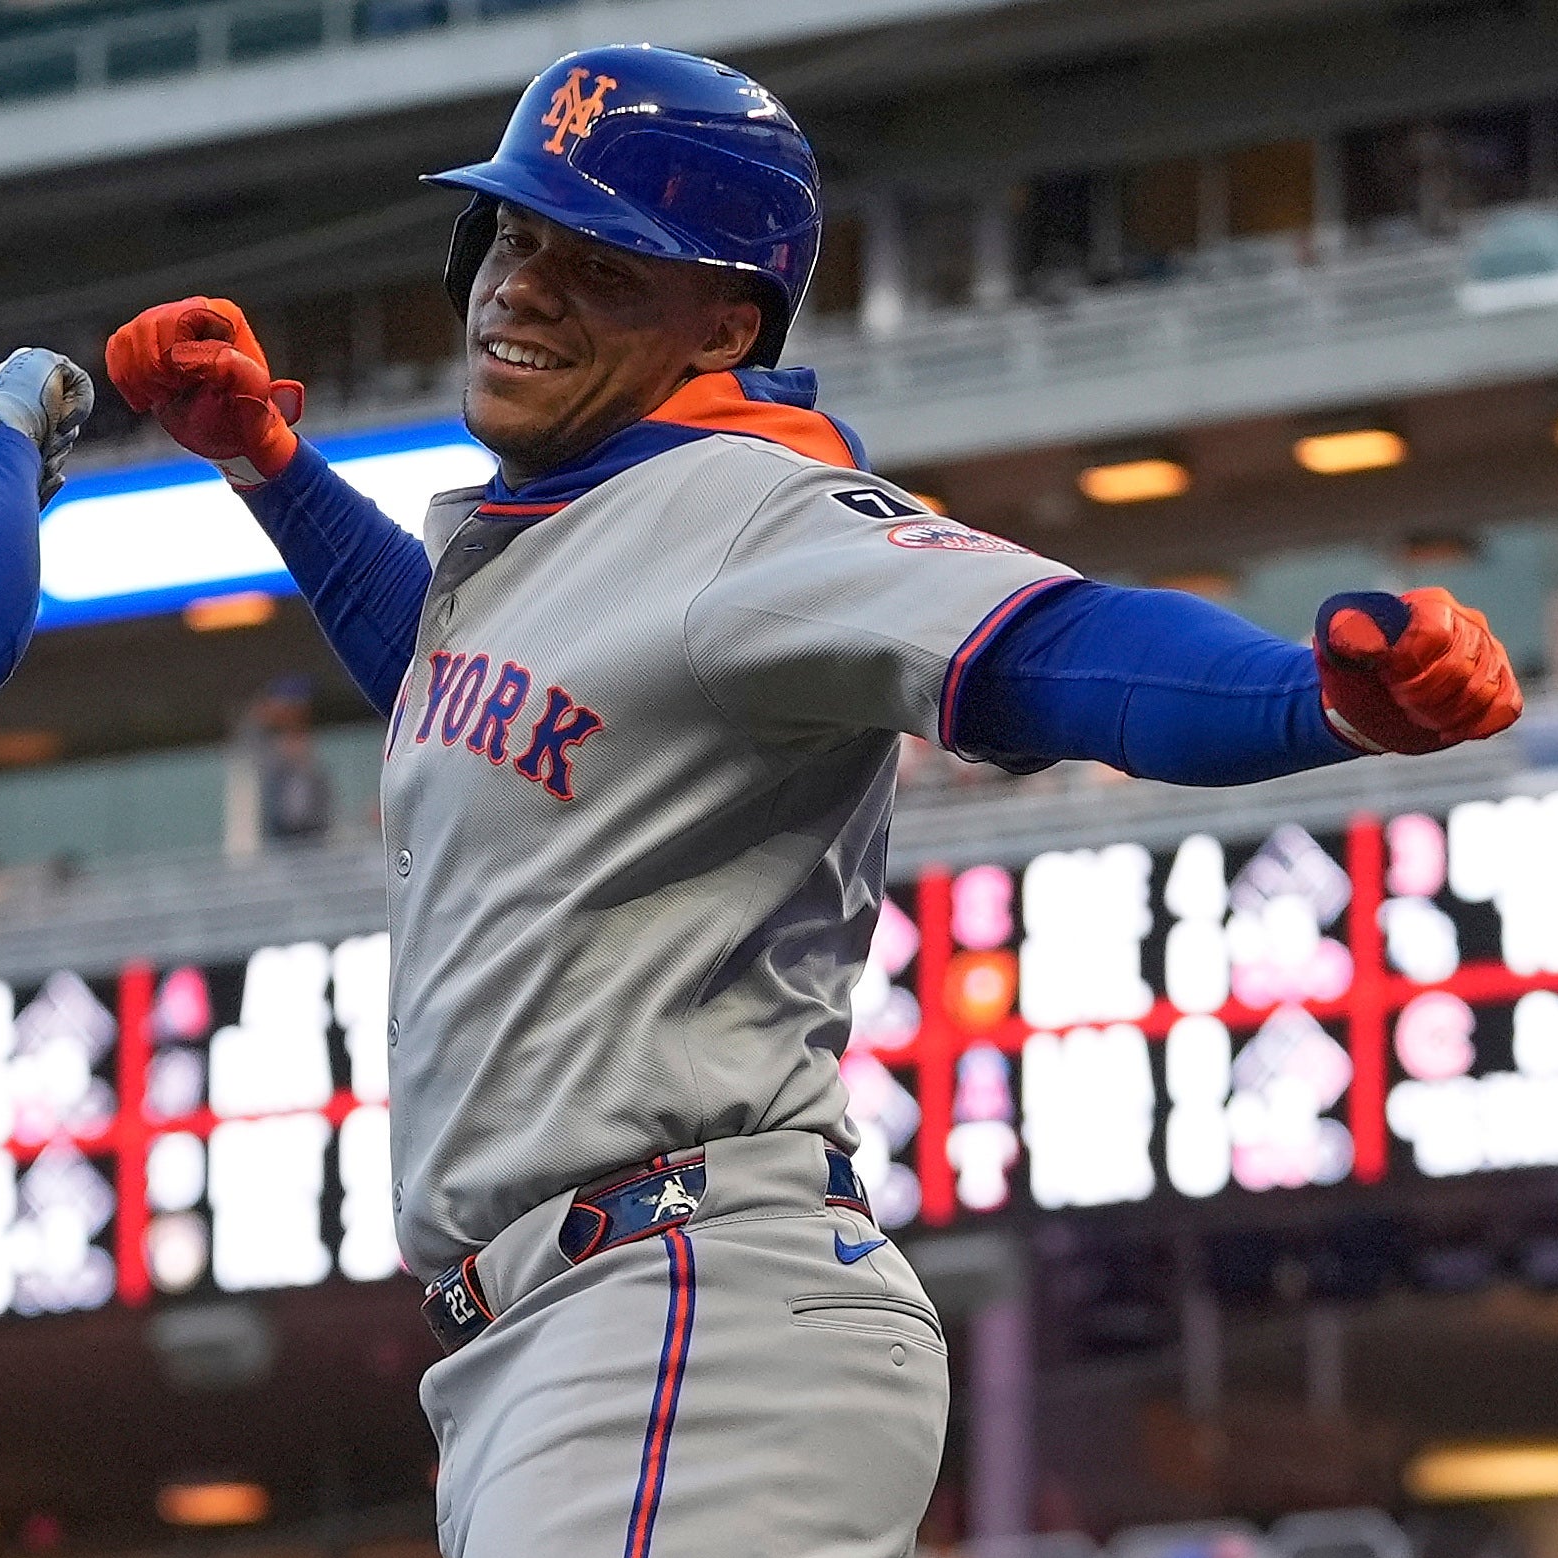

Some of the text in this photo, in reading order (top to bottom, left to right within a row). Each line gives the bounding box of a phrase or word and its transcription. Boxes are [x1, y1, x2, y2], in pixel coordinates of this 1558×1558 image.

[851, 492, 896, 517] 7
[415, 650, 604, 801] YORK
[445, 1283, 477, 1325] 22
